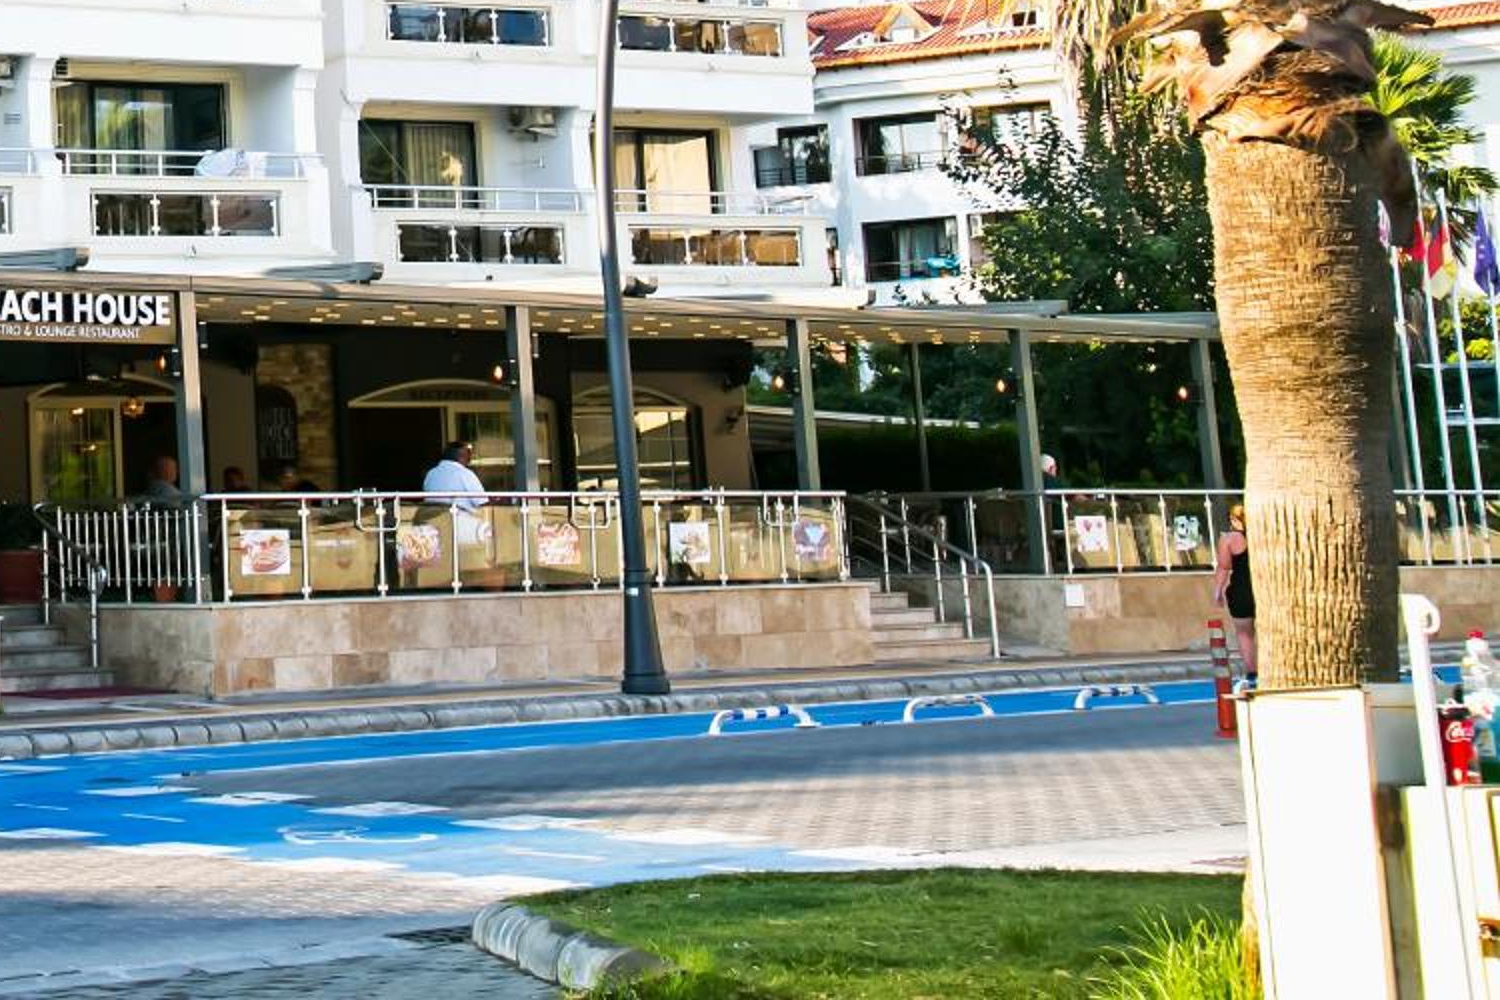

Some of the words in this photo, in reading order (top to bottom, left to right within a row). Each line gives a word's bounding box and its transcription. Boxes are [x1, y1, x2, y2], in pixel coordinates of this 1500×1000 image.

[73, 292, 171, 326] HOUSE
[23, 324, 32, 337] &
[35, 324, 77, 338] LOUNGE
[80, 325, 141, 339] RESTAURANT
